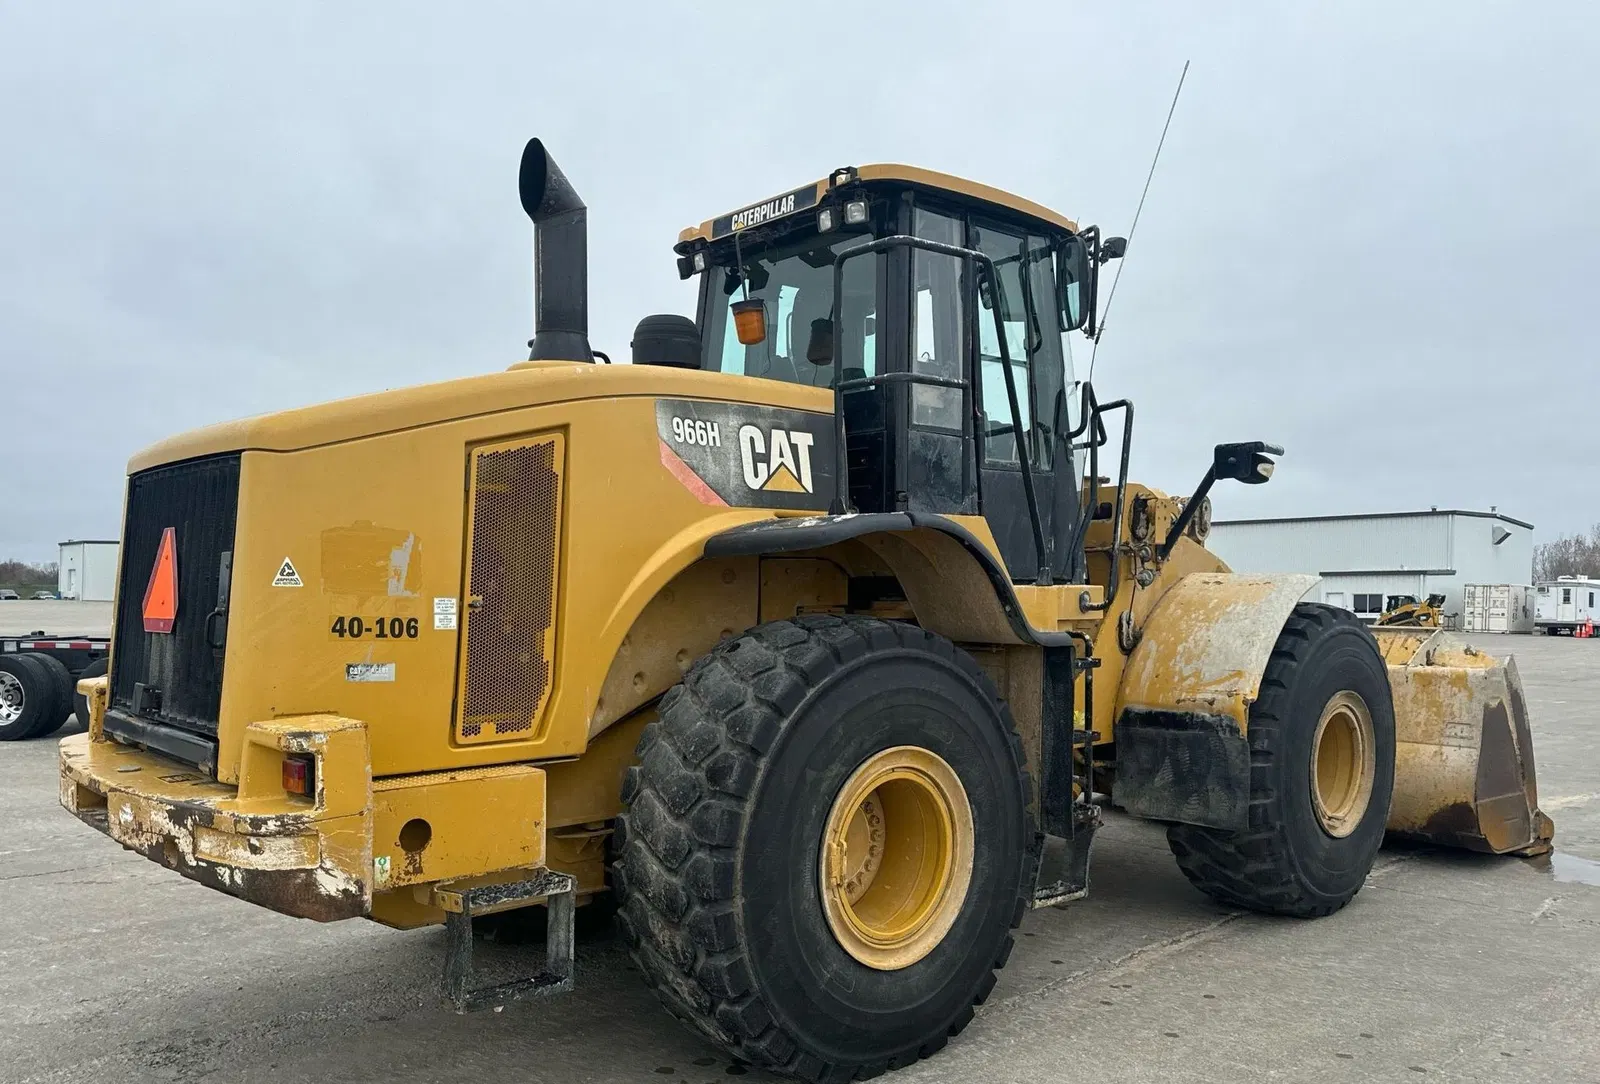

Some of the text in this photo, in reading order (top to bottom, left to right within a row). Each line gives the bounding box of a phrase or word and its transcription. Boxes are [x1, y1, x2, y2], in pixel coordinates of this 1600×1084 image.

[731, 194, 795, 231] CATERPILLAR
[672, 416, 721, 447] 966H
[739, 424, 814, 494] CAT
[331, 616, 419, 639] 40-106
